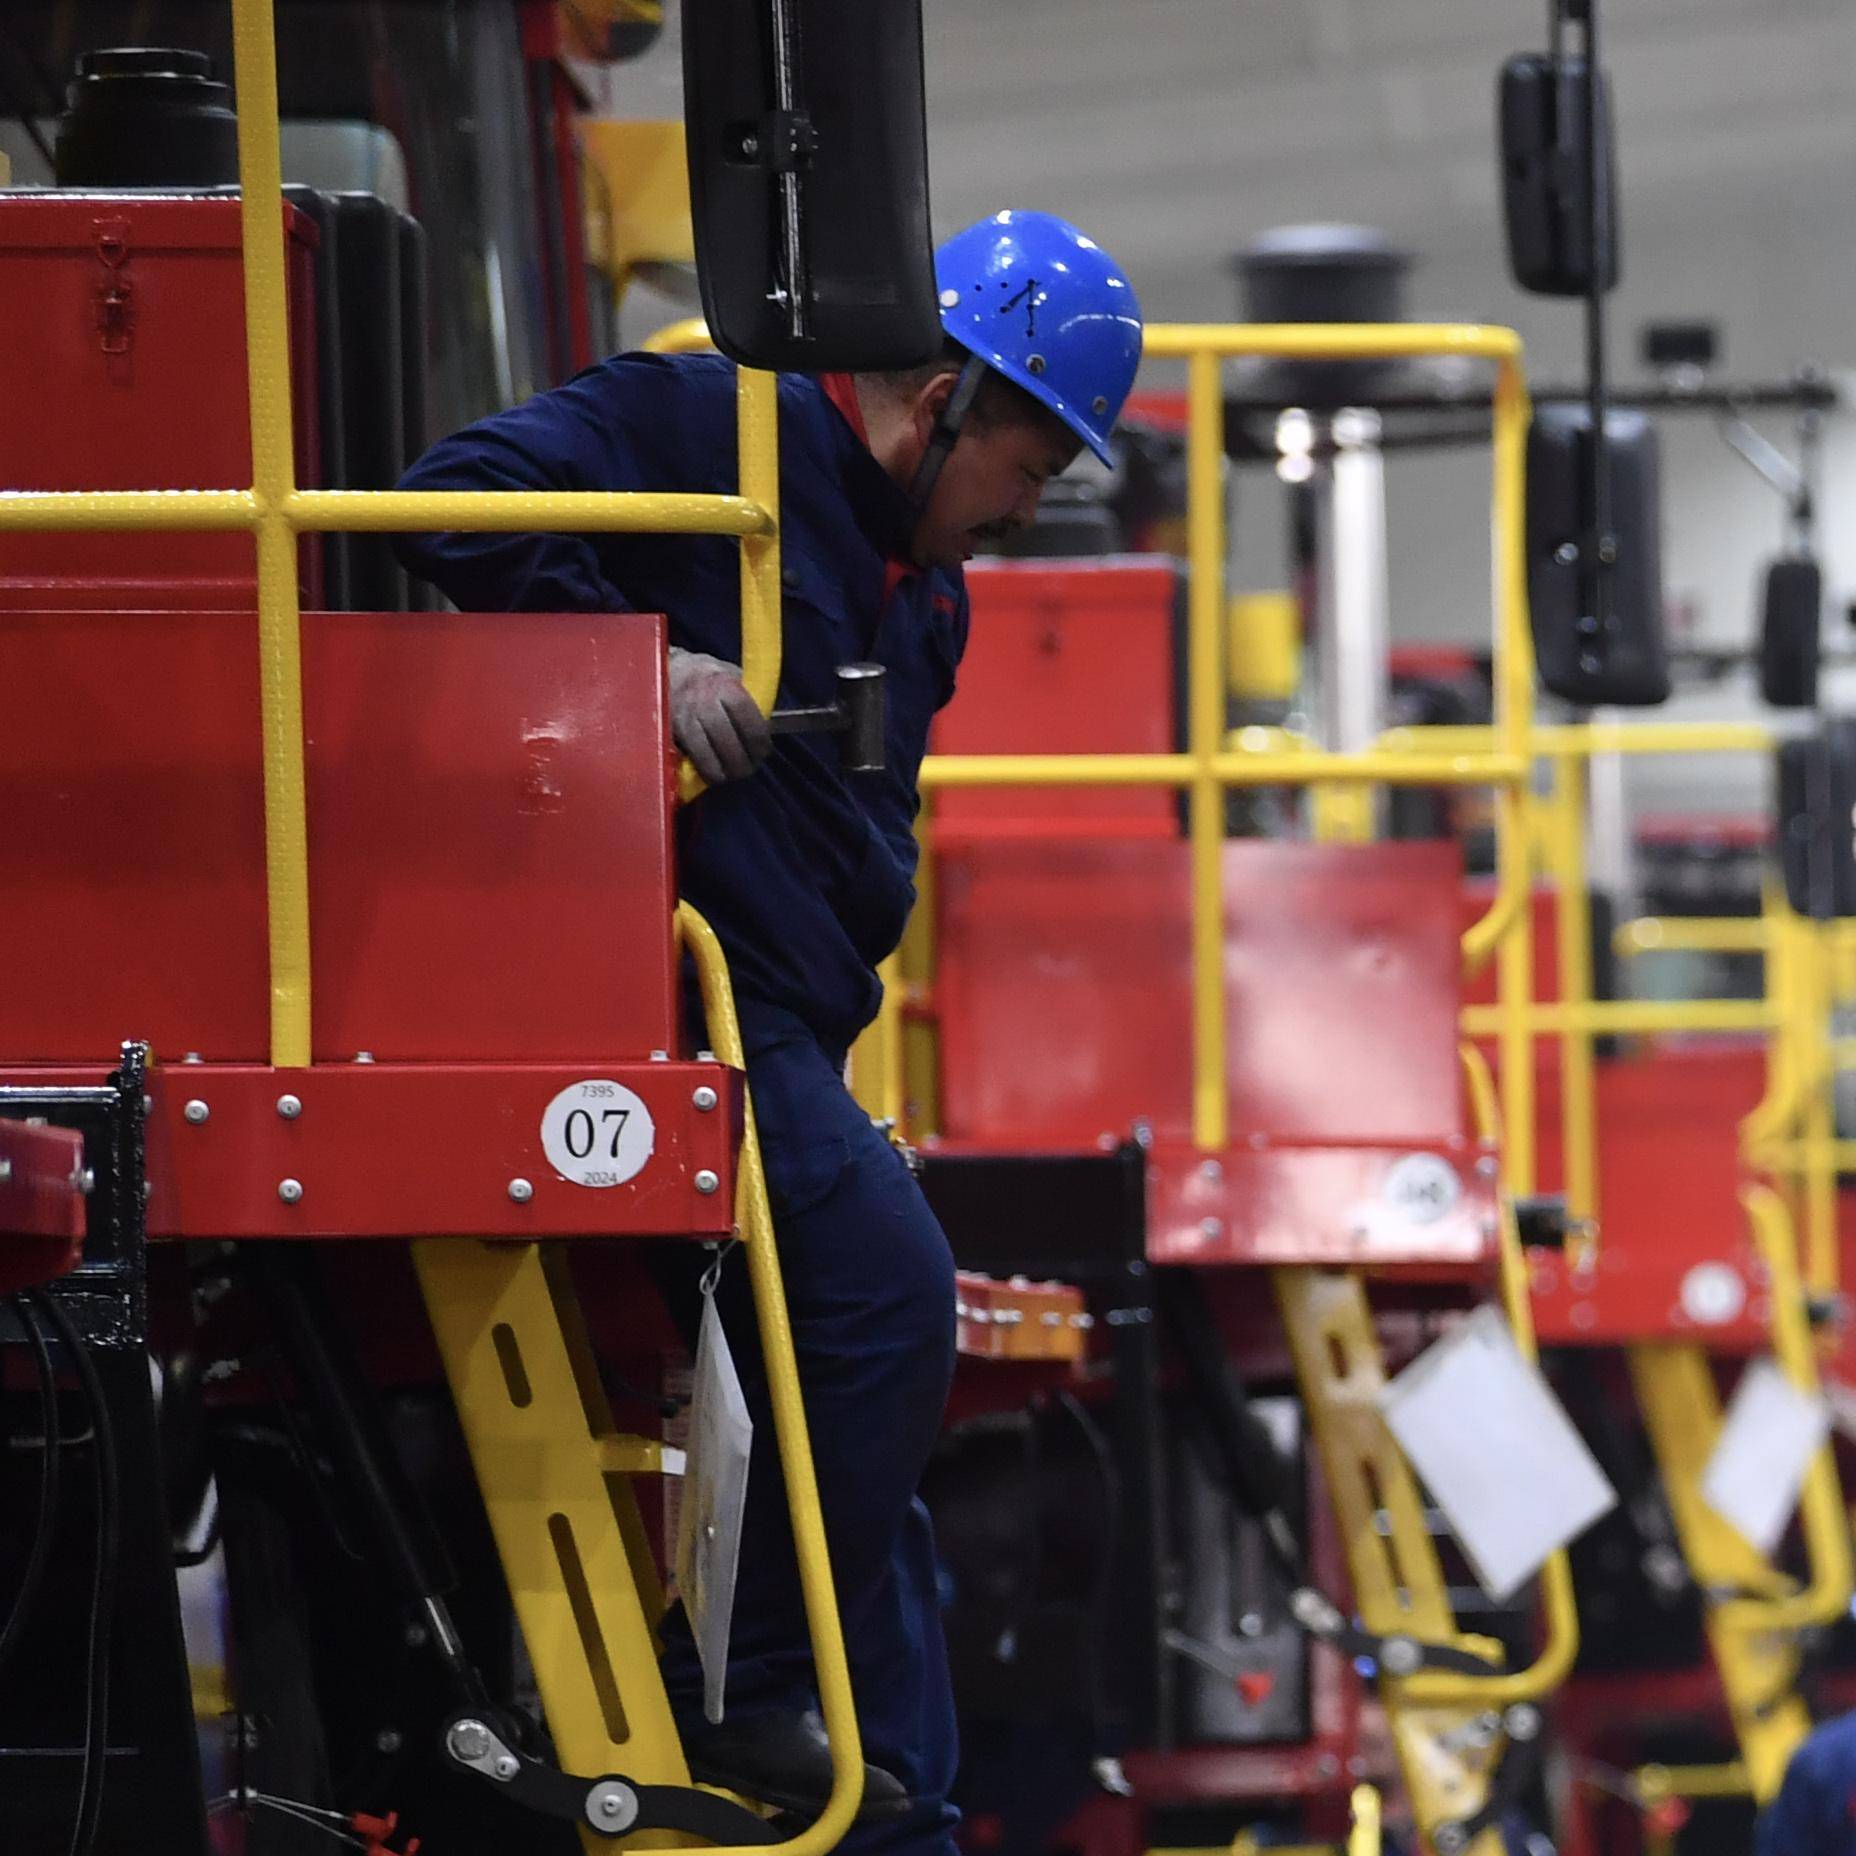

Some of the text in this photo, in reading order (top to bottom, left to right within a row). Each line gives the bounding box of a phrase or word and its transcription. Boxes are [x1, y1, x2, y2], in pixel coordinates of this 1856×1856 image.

[582, 1085, 615, 1098] 7395
[565, 1109, 630, 1158] 07
[584, 1172, 618, 1185] 2024
